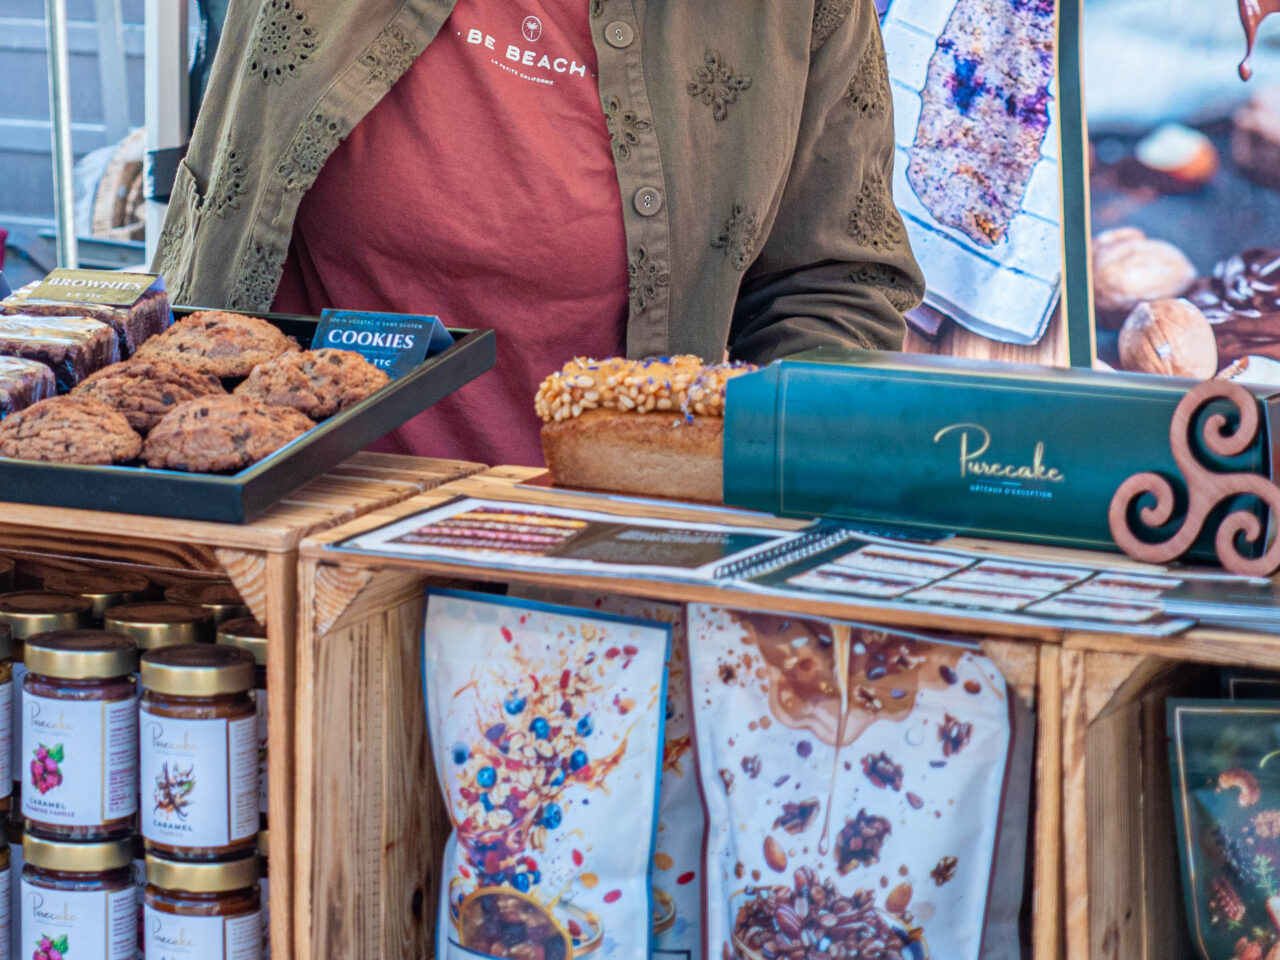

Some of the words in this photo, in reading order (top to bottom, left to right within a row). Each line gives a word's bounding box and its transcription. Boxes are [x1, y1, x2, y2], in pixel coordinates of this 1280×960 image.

[467, 28, 496, 50] BE
[505, 44, 586, 77] BEACH
[47, 277, 143, 290] BROWNIES
[328, 329, 415, 349] COOKIES
[373, 359, 392, 367] TTC
[933, 423, 1065, 481] Purecake
[29, 797, 66, 809] CARAMEL
[152, 820, 194, 832] CARAMEL
